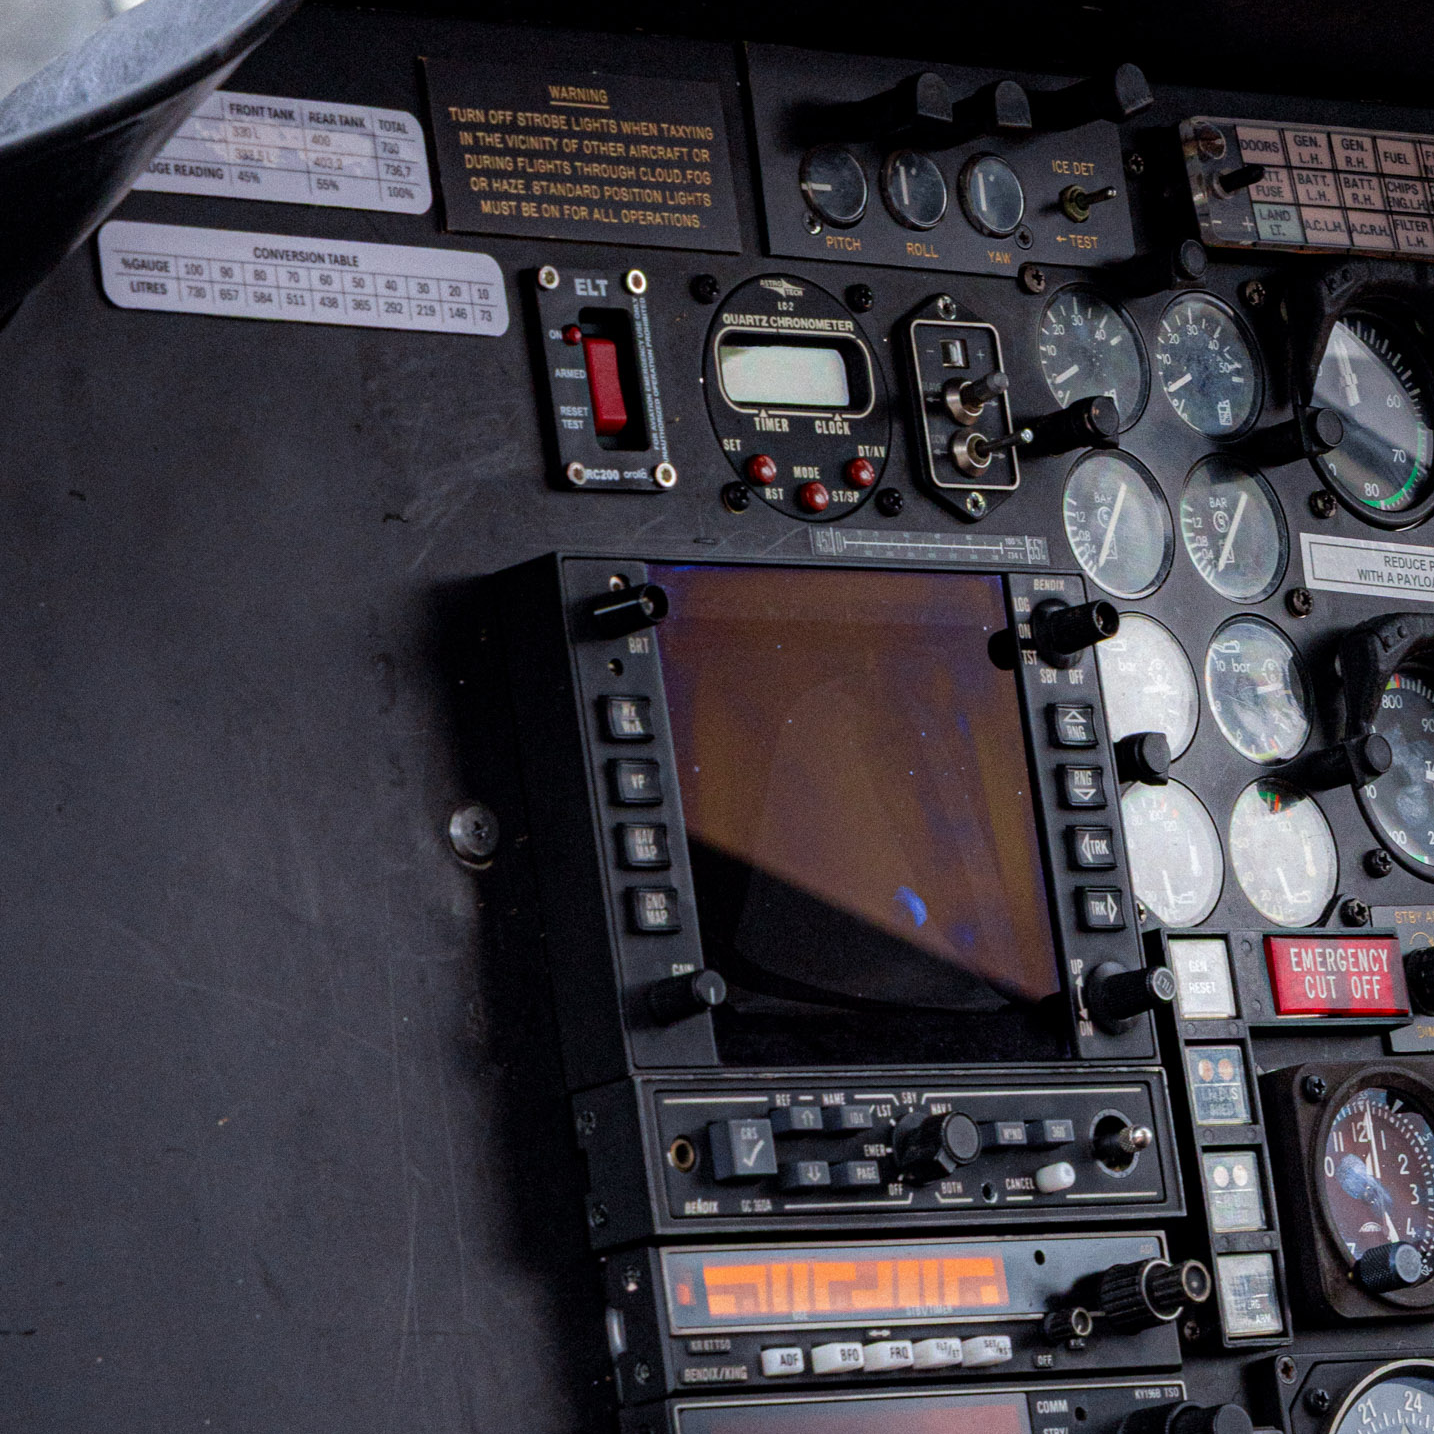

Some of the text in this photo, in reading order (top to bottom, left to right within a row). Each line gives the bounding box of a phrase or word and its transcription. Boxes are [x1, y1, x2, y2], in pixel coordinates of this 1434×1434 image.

[549, 85, 608, 103] WARNING
[230, 103, 408, 133] FRONT TANK REAR TANK TOTAL
[449, 107, 713, 141] TURN OFF STROBE LIGHTS WHEN TAXYING
[460, 131, 710, 163] IN THE VICINITY OF OTHER AIRCRAFT OR
[1240, 139, 1280, 153] DOORS
[1294, 135, 1321, 149] GEN.
[1383, 151, 1410, 165] FUEL
[464, 154, 636, 179] DURING FLIGHTS THROUGH
[1052, 160, 1096, 176] ICE DET
[470, 177, 712, 207] OR POSITION LIGHTS
[481, 200, 516, 215] MUST
[521, 202, 539, 217] BE
[542, 204, 560, 218] ON
[564, 205, 588, 220] FOR
[593, 209, 618, 223] ALL
[826, 236, 861, 251] PITCH
[1069, 234, 1098, 249] TEST
[254, 247, 359, 267] CONVERSION TABLE
[907, 242, 939, 258] ROLL
[987, 249, 1012, 264] YAW
[130, 281, 167, 295] LITRES
[574, 278, 608, 296] ELT
[723, 314, 854, 332] QUARTZ CHRONOMETER
[555, 369, 586, 379] ARMED
[560, 406, 588, 416] RESET
[561, 419, 584, 429] TEST
[754, 417, 851, 435] TIMER CLOCK
[723, 439, 741, 451] SET
[793, 466, 820, 479] MODE
[765, 488, 783, 500] RST
[832, 490, 859, 503] ST/SP
[1384, 555, 1428, 571] REDUCE
[1357, 568, 1384, 583] WITH
[1387, 572, 1394, 583] A
[1034, 579, 1064, 591] BENDIX
[1022, 650, 1037, 665] TST
[1040, 668, 1083, 684] SBY OFF
[1395, 911, 1423, 924] STBY
[1290, 947, 1390, 973] EMERGENCY
[1304, 975, 1382, 999] CUT OFF
[864, 1144, 886, 1157] EMER
[1006, 1178, 1035, 1191] CANCEL
[1037, 1400, 1068, 1414] COMM
